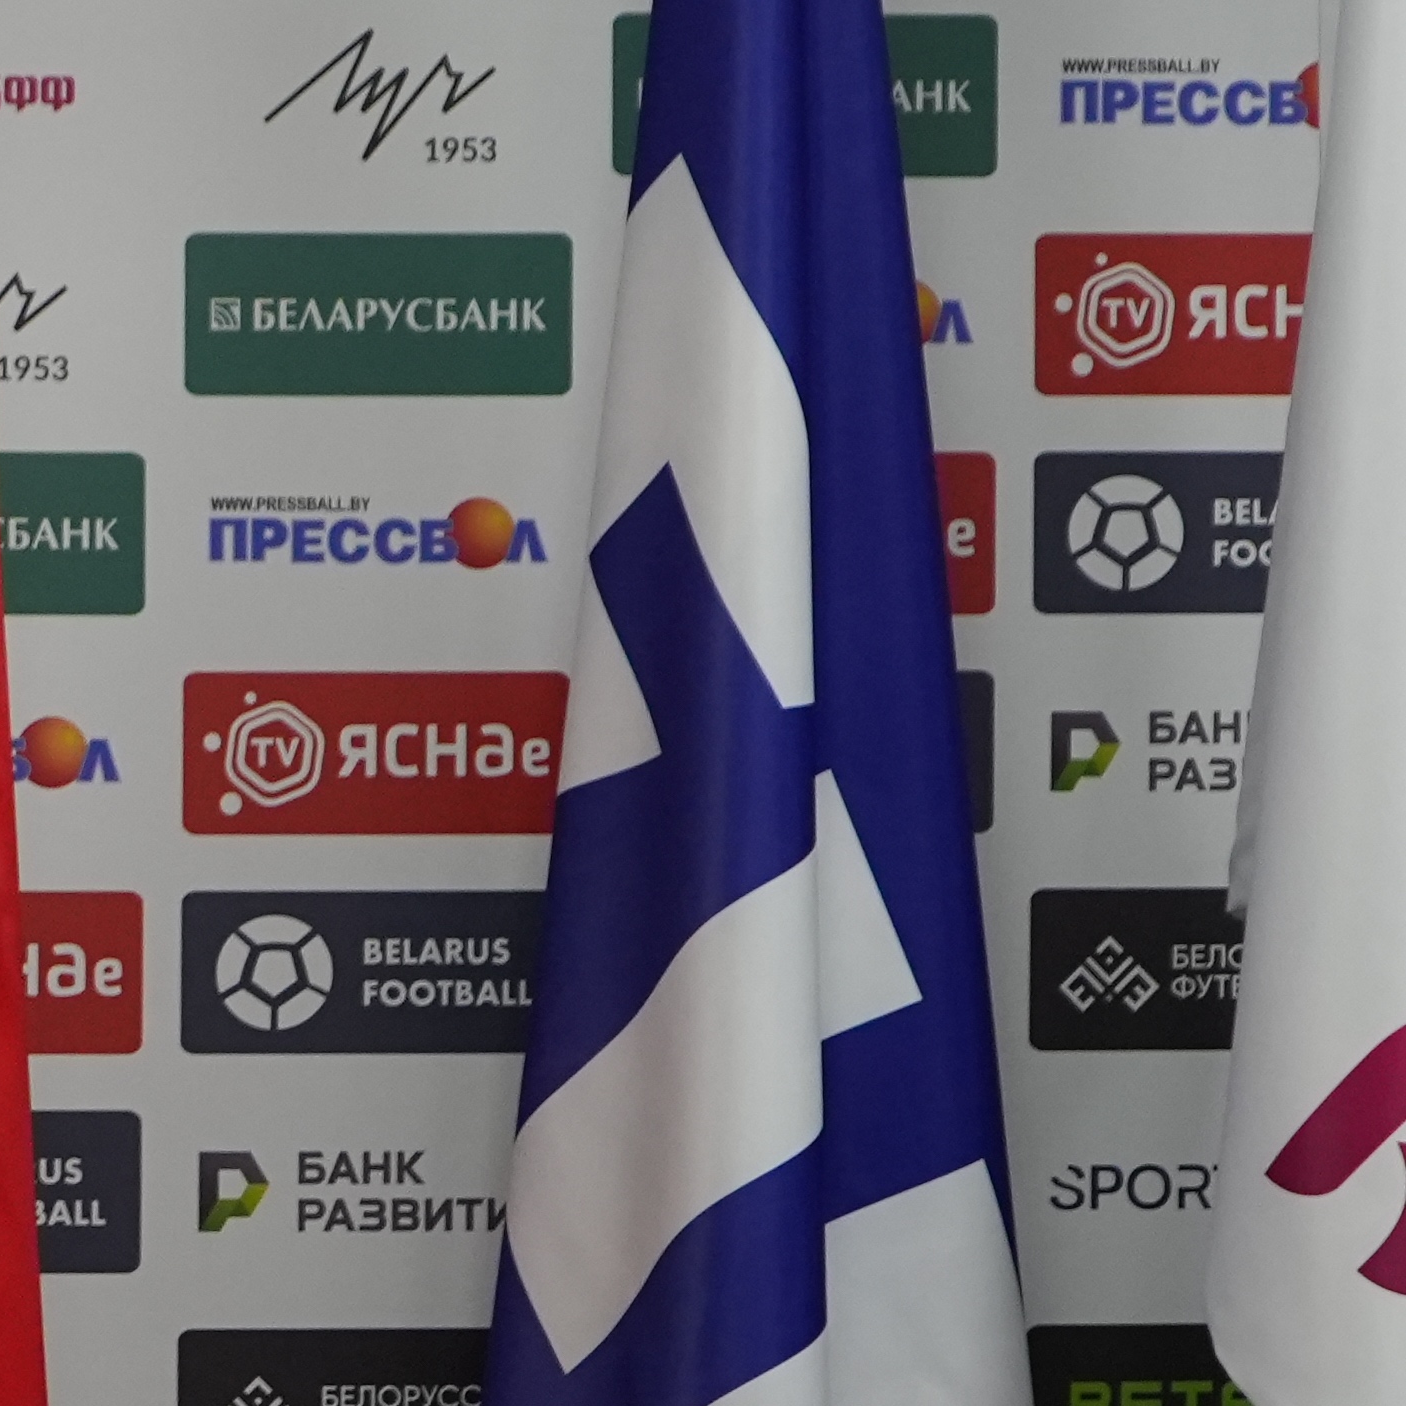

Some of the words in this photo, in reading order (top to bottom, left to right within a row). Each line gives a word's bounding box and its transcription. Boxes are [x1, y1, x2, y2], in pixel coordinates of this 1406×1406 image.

[1061, 57, 1220, 74] WWW.PRESSBALL.BY
[424, 136, 497, 163] 1953
[253, 297, 546, 334] БЕЛАРУСБАНК
[1103, 297, 1150, 328] TV
[210, 496, 371, 512] WWW.PRESSBALL.BY
[0, 516, 120, 551] БАНК
[1149, 710, 1250, 744] БАН
[250, 736, 300, 768] TV
[363, 937, 511, 966] BELARUS
[363, 978, 533, 1007] FOOTBALL
[36, 1156, 84, 1186] US
[298, 1151, 425, 1185] БАНК
[1050, 1164, 1218, 1210] SPOR
